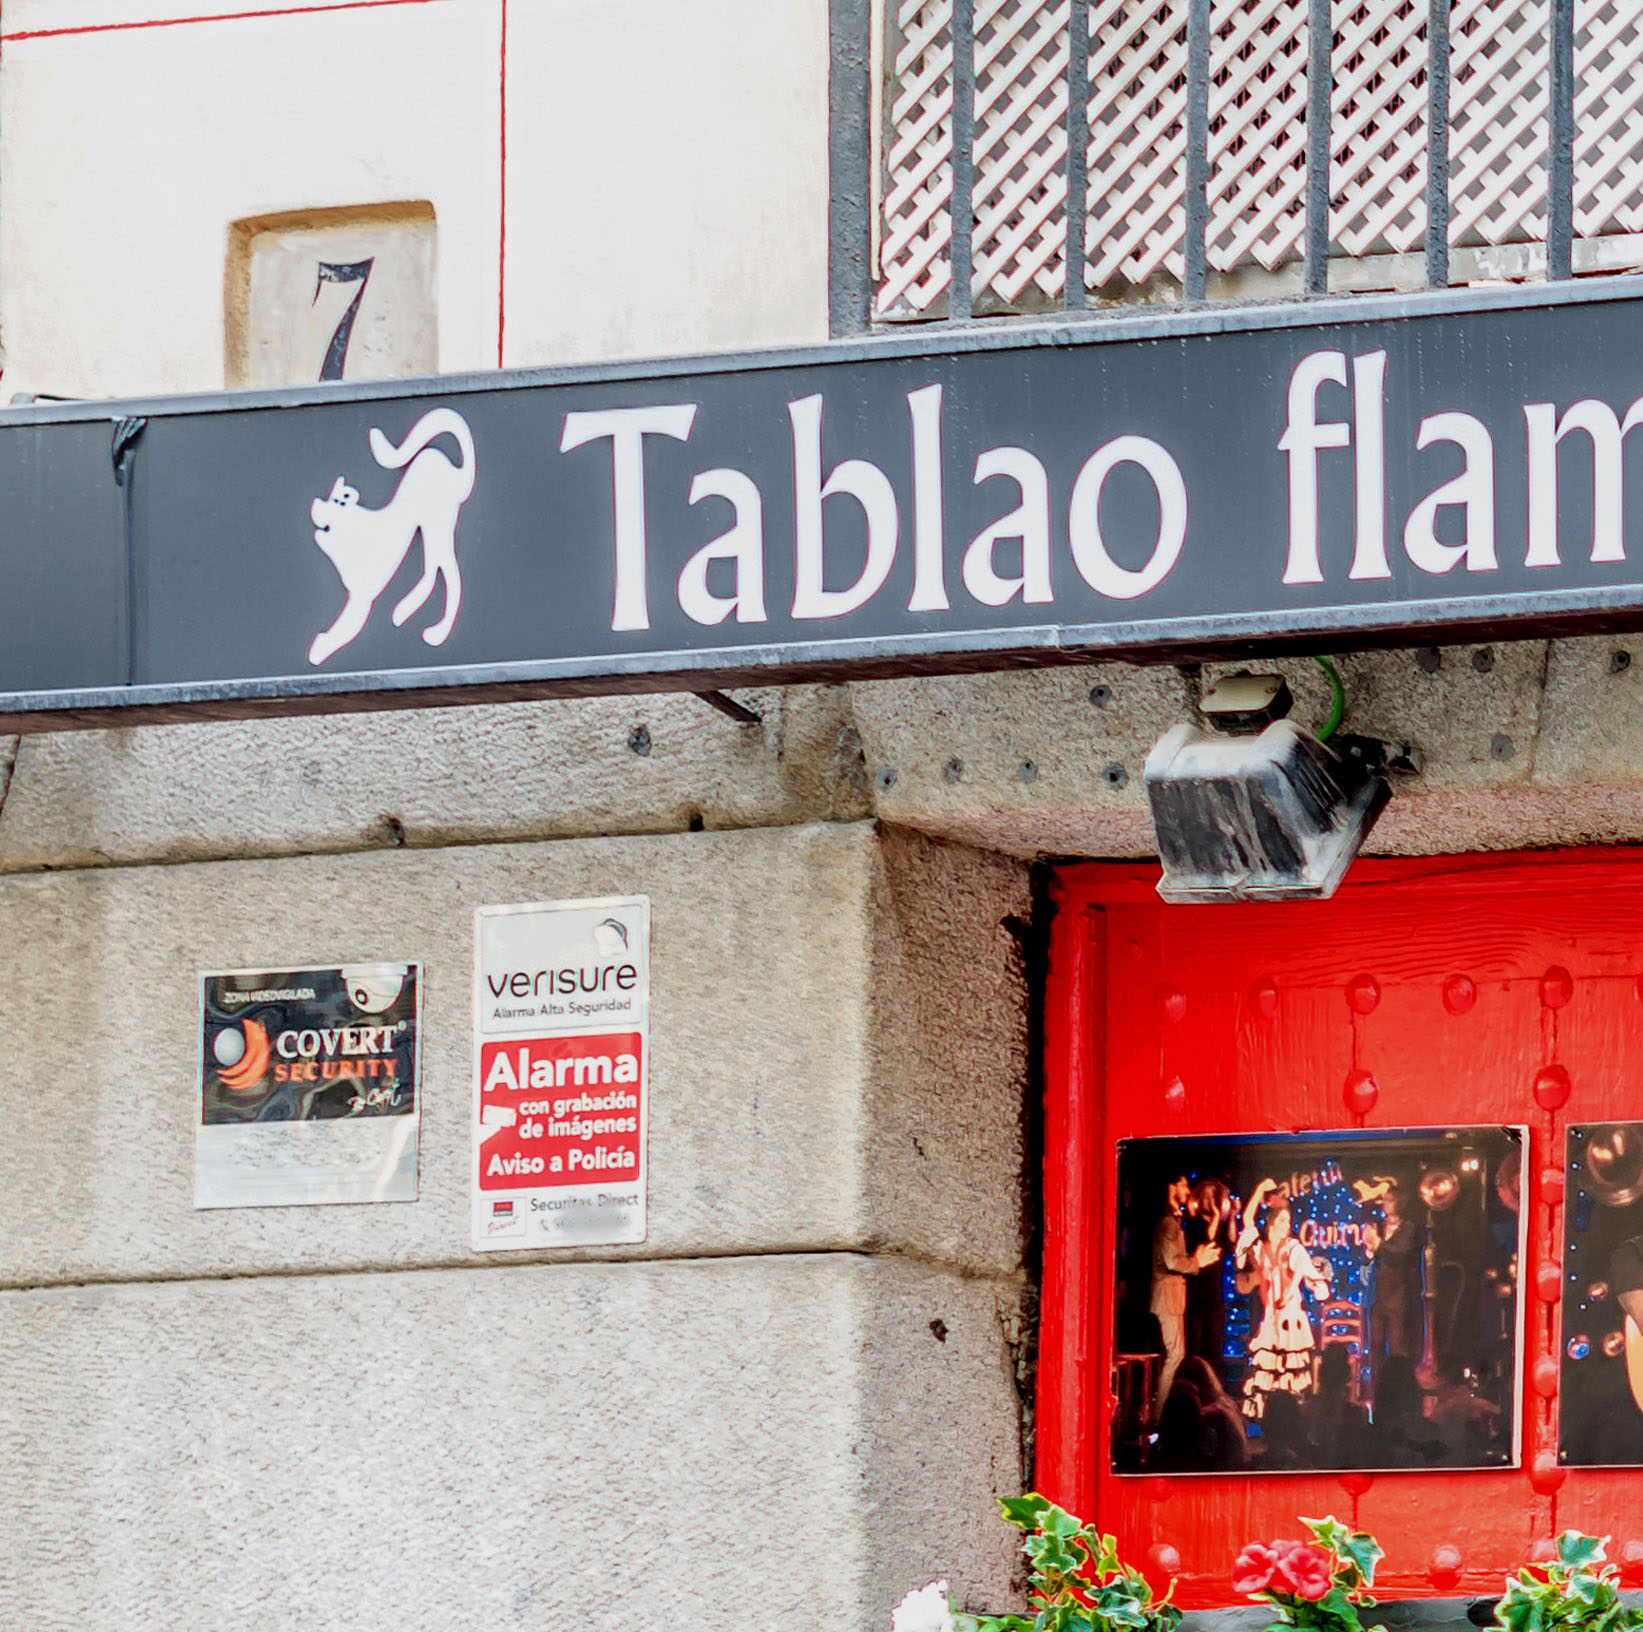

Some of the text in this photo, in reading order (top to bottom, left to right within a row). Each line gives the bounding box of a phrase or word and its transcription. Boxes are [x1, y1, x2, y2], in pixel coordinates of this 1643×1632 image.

[311, 256, 375, 382] 7
[559, 383, 1189, 632] Tablao
[487, 964, 638, 999] verisure
[493, 998, 632, 1019] Alarma Alta Seguridad
[276, 1025, 397, 1058] COVERT
[275, 1058, 398, 1082] SECURITY
[484, 1048, 639, 1092] Alarma
[519, 1091, 637, 1118] con grabación
[519, 1115, 637, 1140] de imágenes
[487, 1146, 635, 1176] Aviso a Policía
